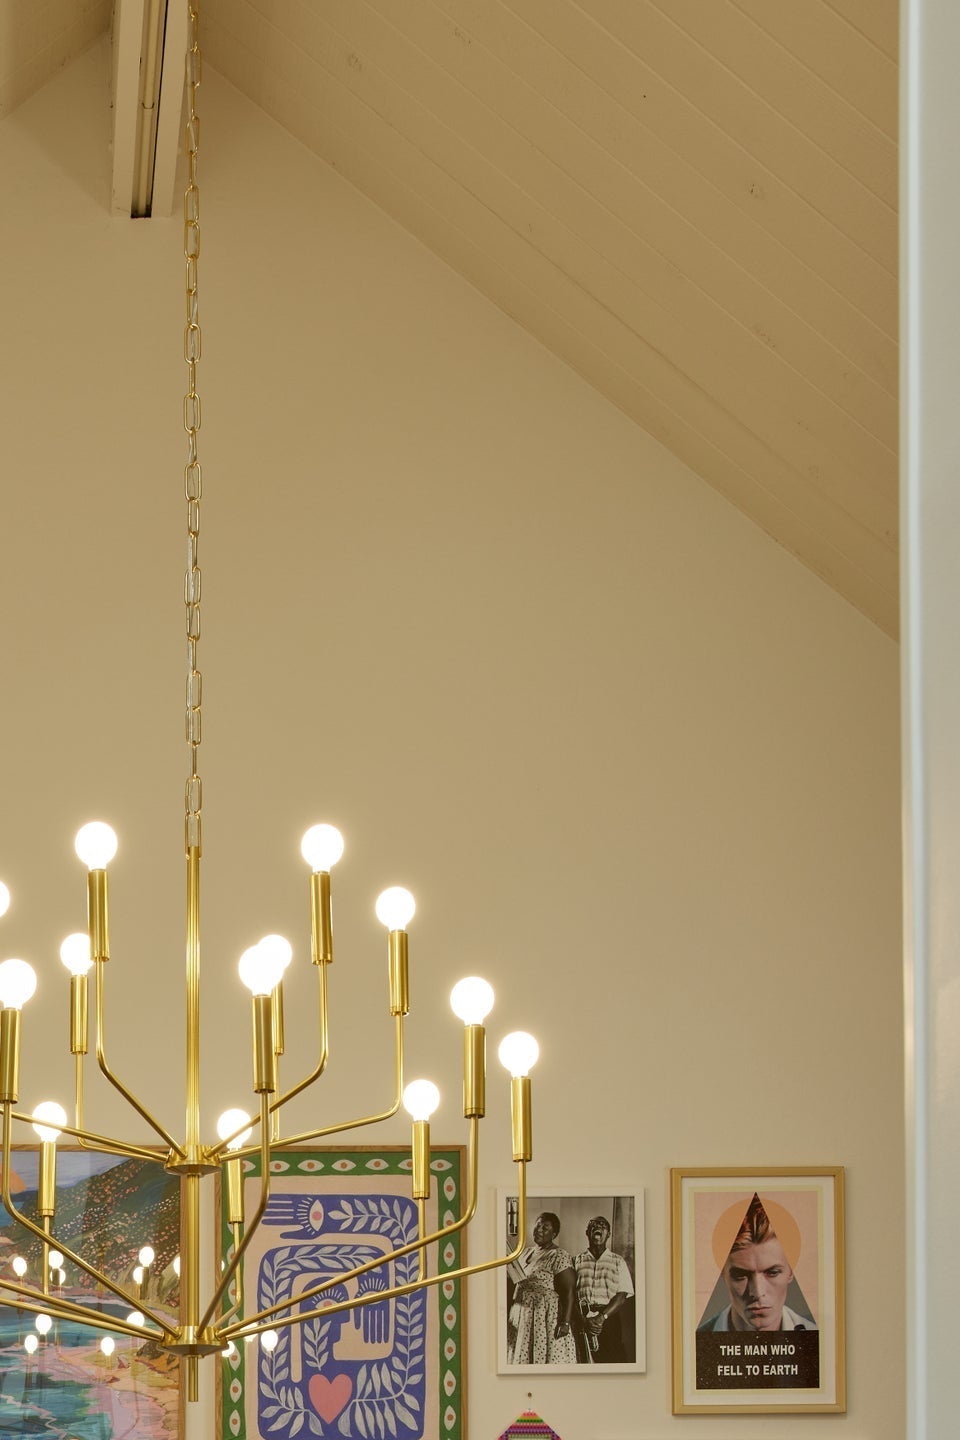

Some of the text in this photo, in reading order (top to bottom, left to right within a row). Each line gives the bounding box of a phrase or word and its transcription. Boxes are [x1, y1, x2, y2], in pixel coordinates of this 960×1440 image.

[719, 1344, 796, 1356] THE MAN WHO
[717, 1364, 799, 1376] FELL TO EARTH
